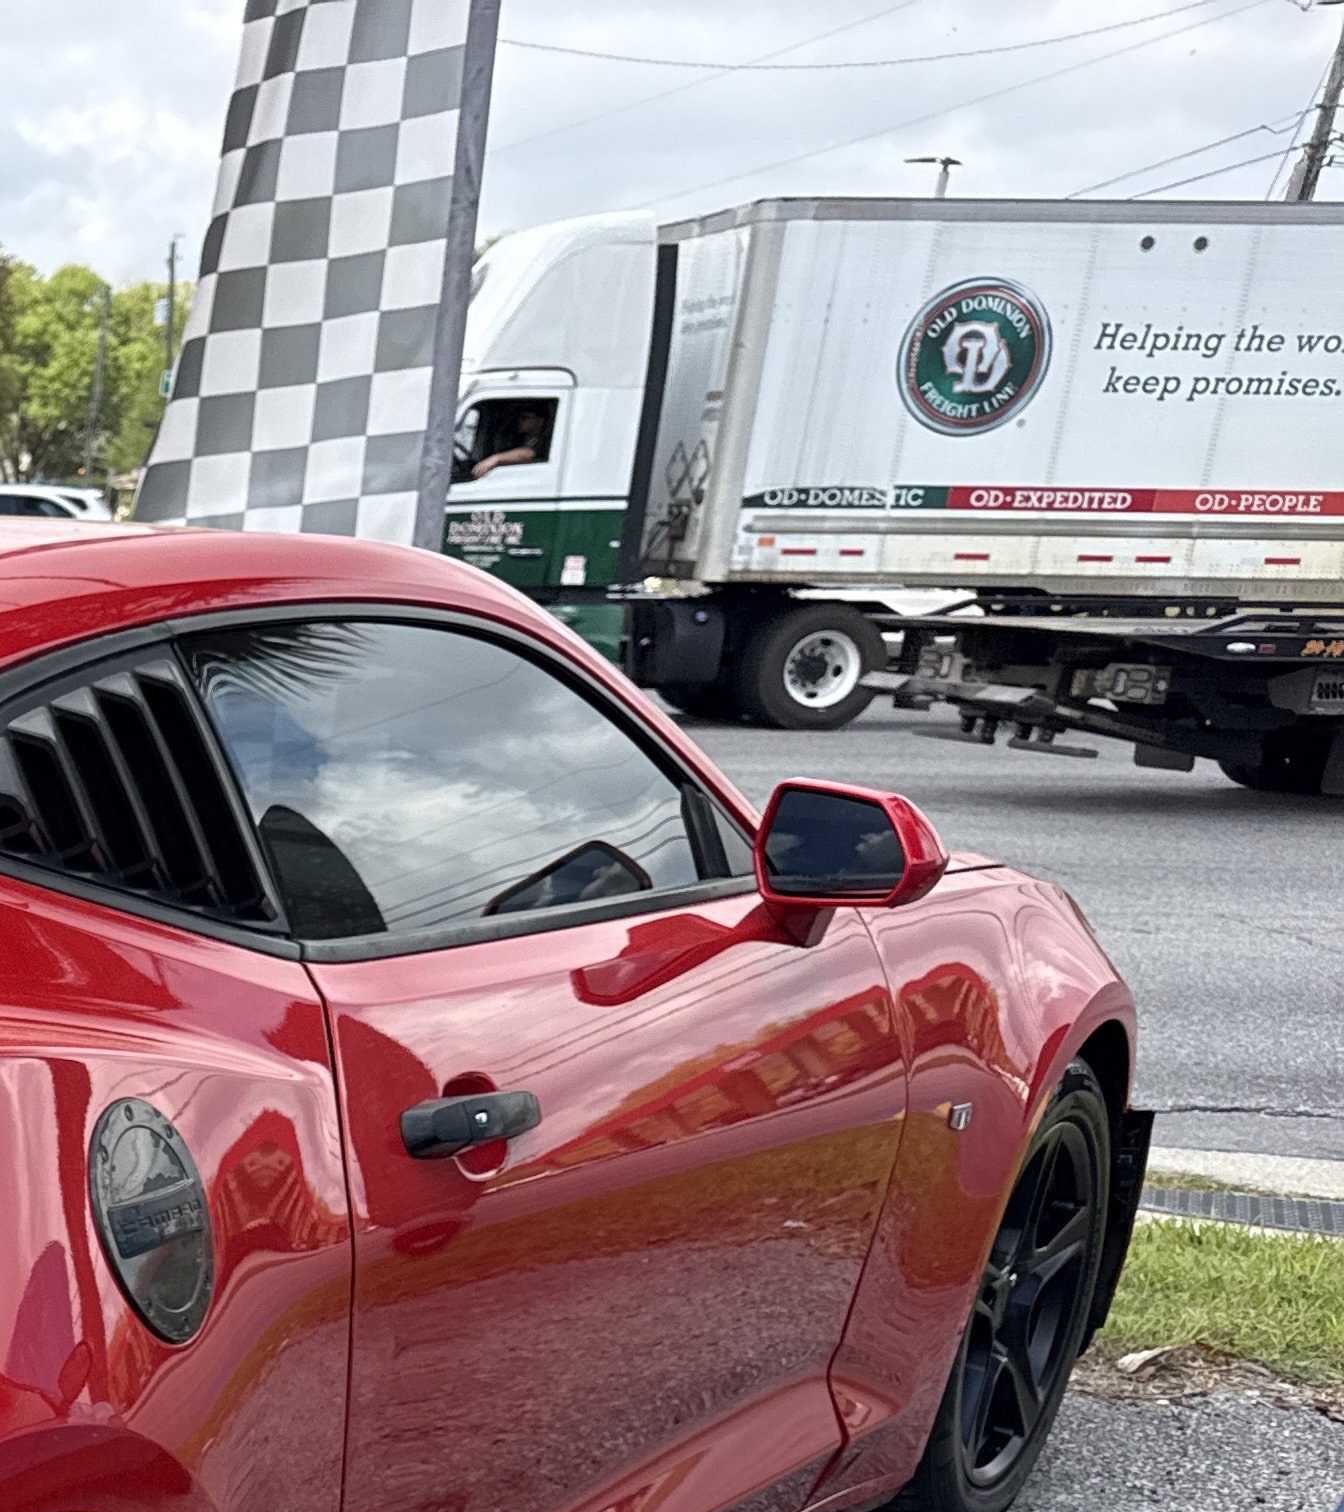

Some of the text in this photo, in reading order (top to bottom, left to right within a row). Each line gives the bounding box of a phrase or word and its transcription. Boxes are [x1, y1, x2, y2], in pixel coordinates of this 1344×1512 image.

[926, 296, 1032, 339] OLD DOMINION
[1093, 322, 1344, 358] Helping the wo
[919, 381, 980, 418] FREIGHT
[1103, 366, 1342, 402] keep promises.
